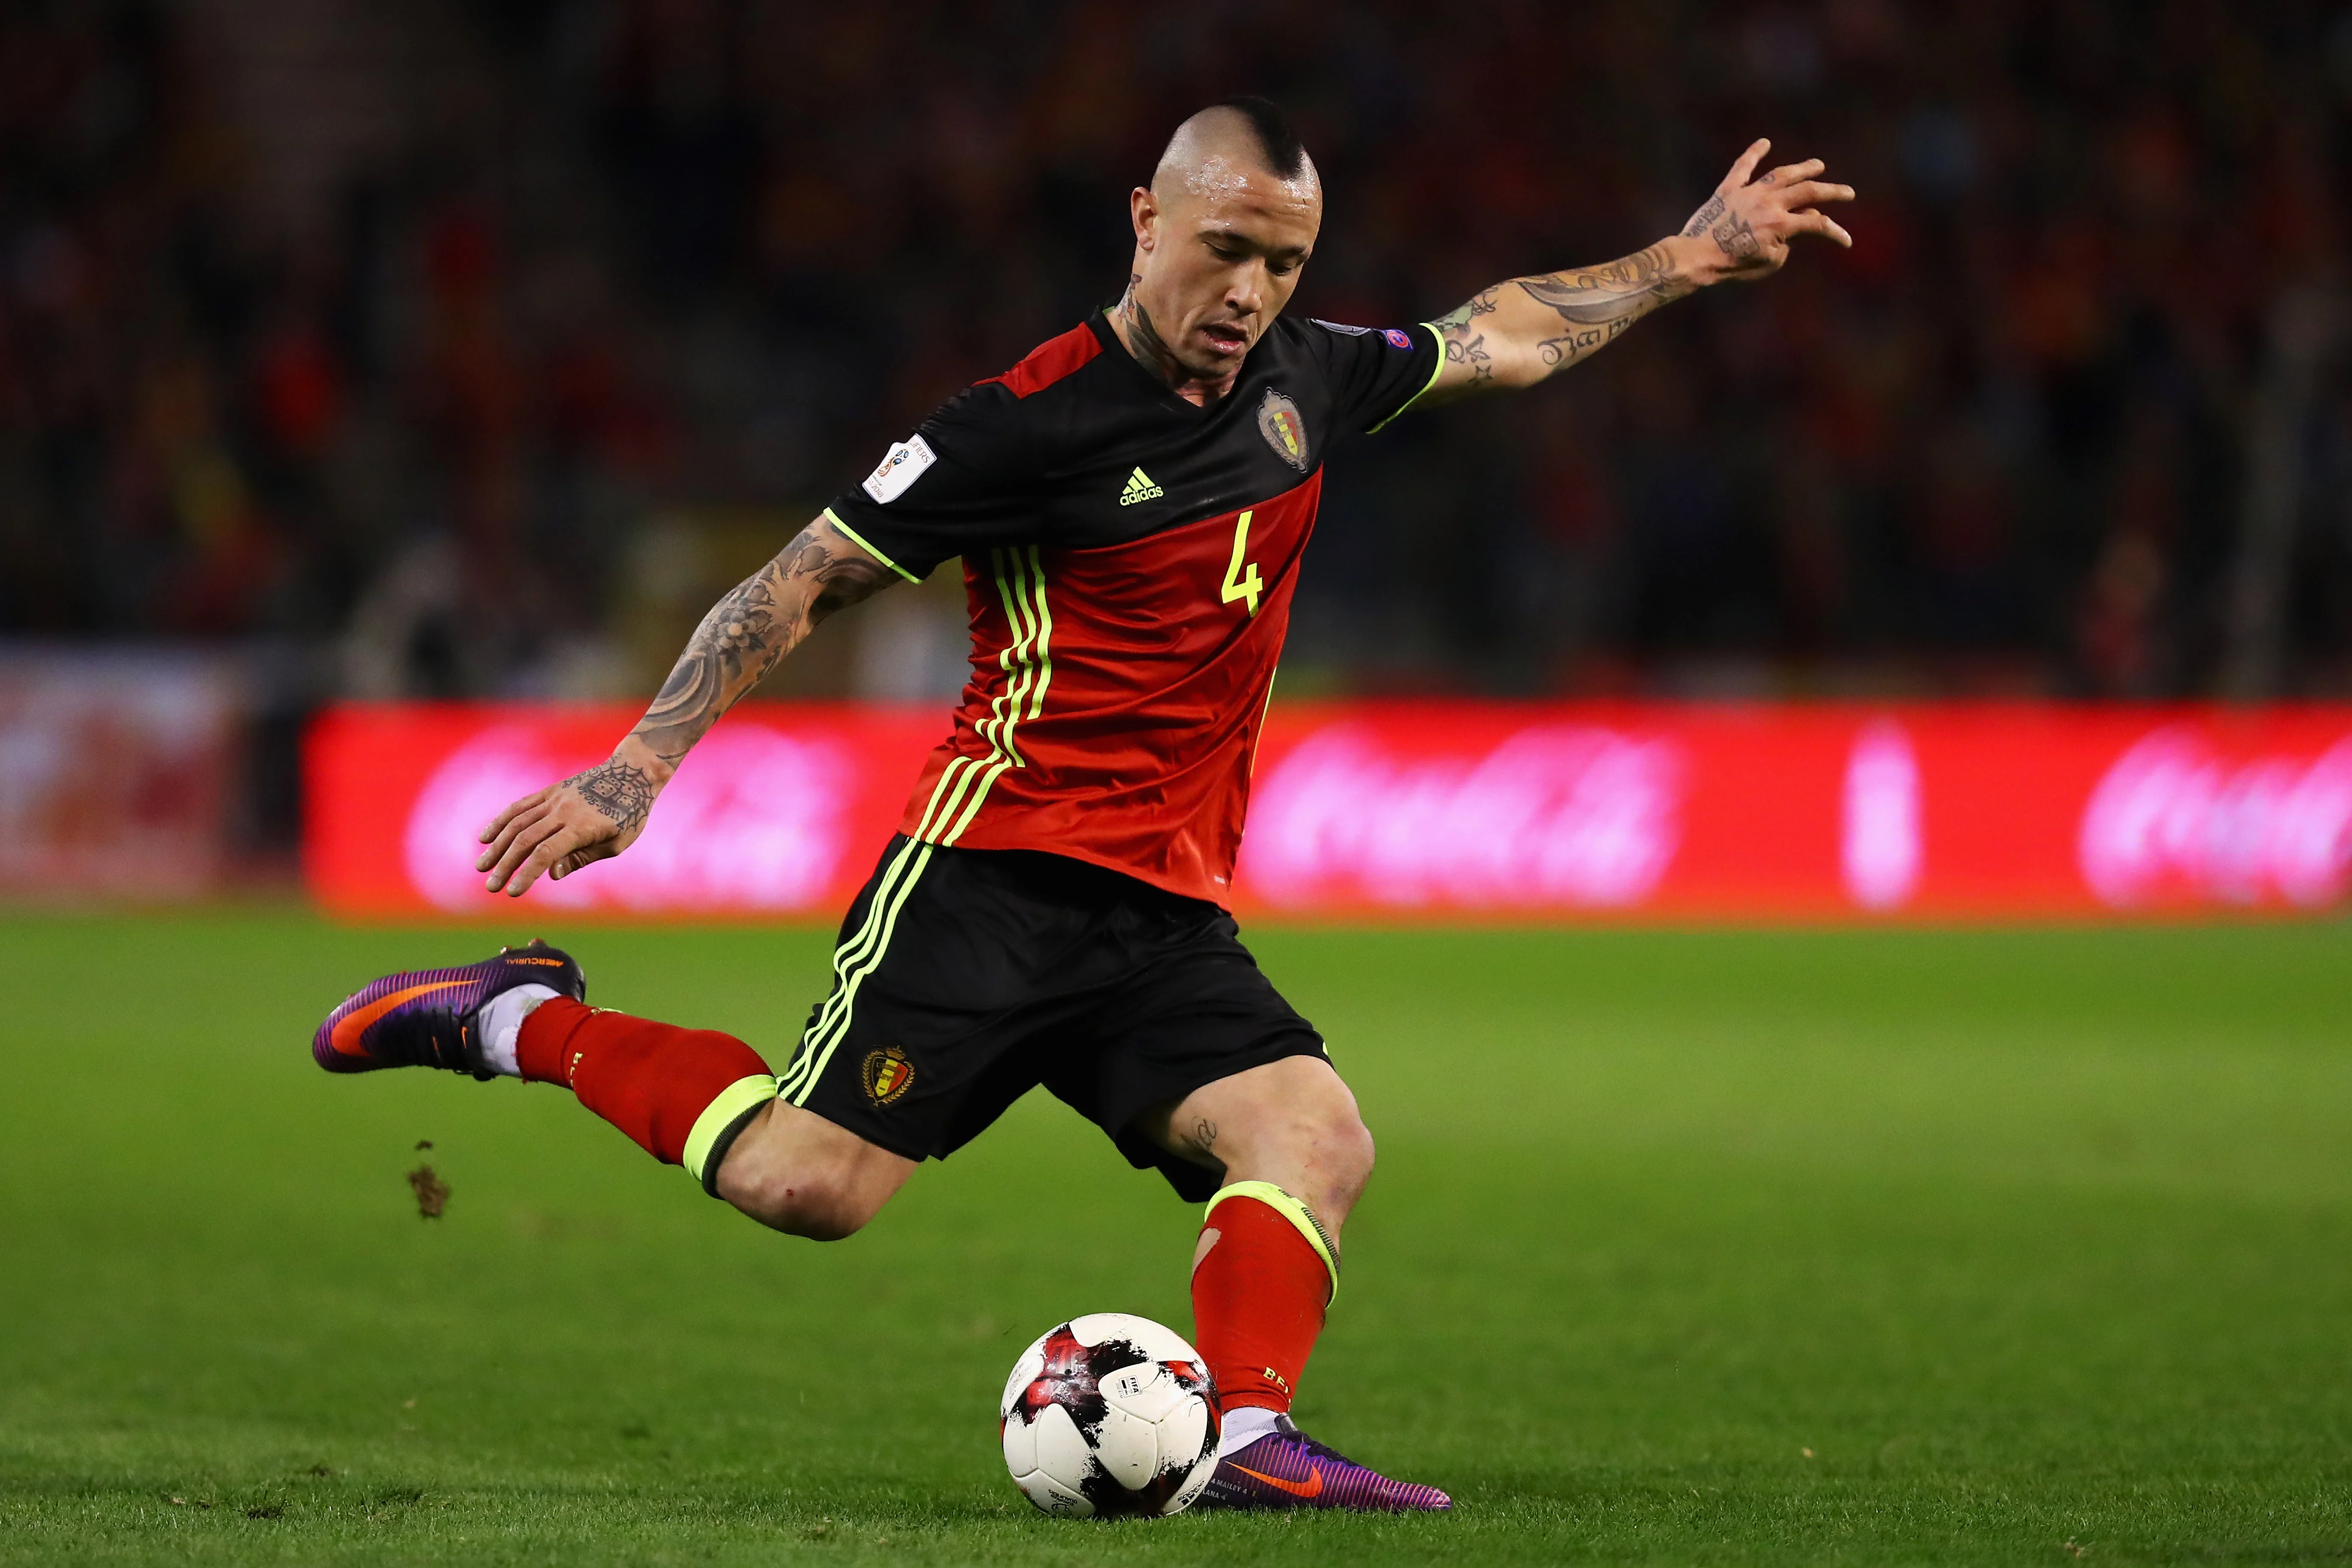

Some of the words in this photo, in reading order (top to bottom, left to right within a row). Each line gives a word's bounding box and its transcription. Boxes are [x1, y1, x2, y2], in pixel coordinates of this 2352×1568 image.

[1120, 486, 1164, 506] adidas
[1221, 510, 1263, 618] 4
[1130, 1377, 1139, 1393] FIFA
[1216, 1479, 1241, 1492] MAILEY
